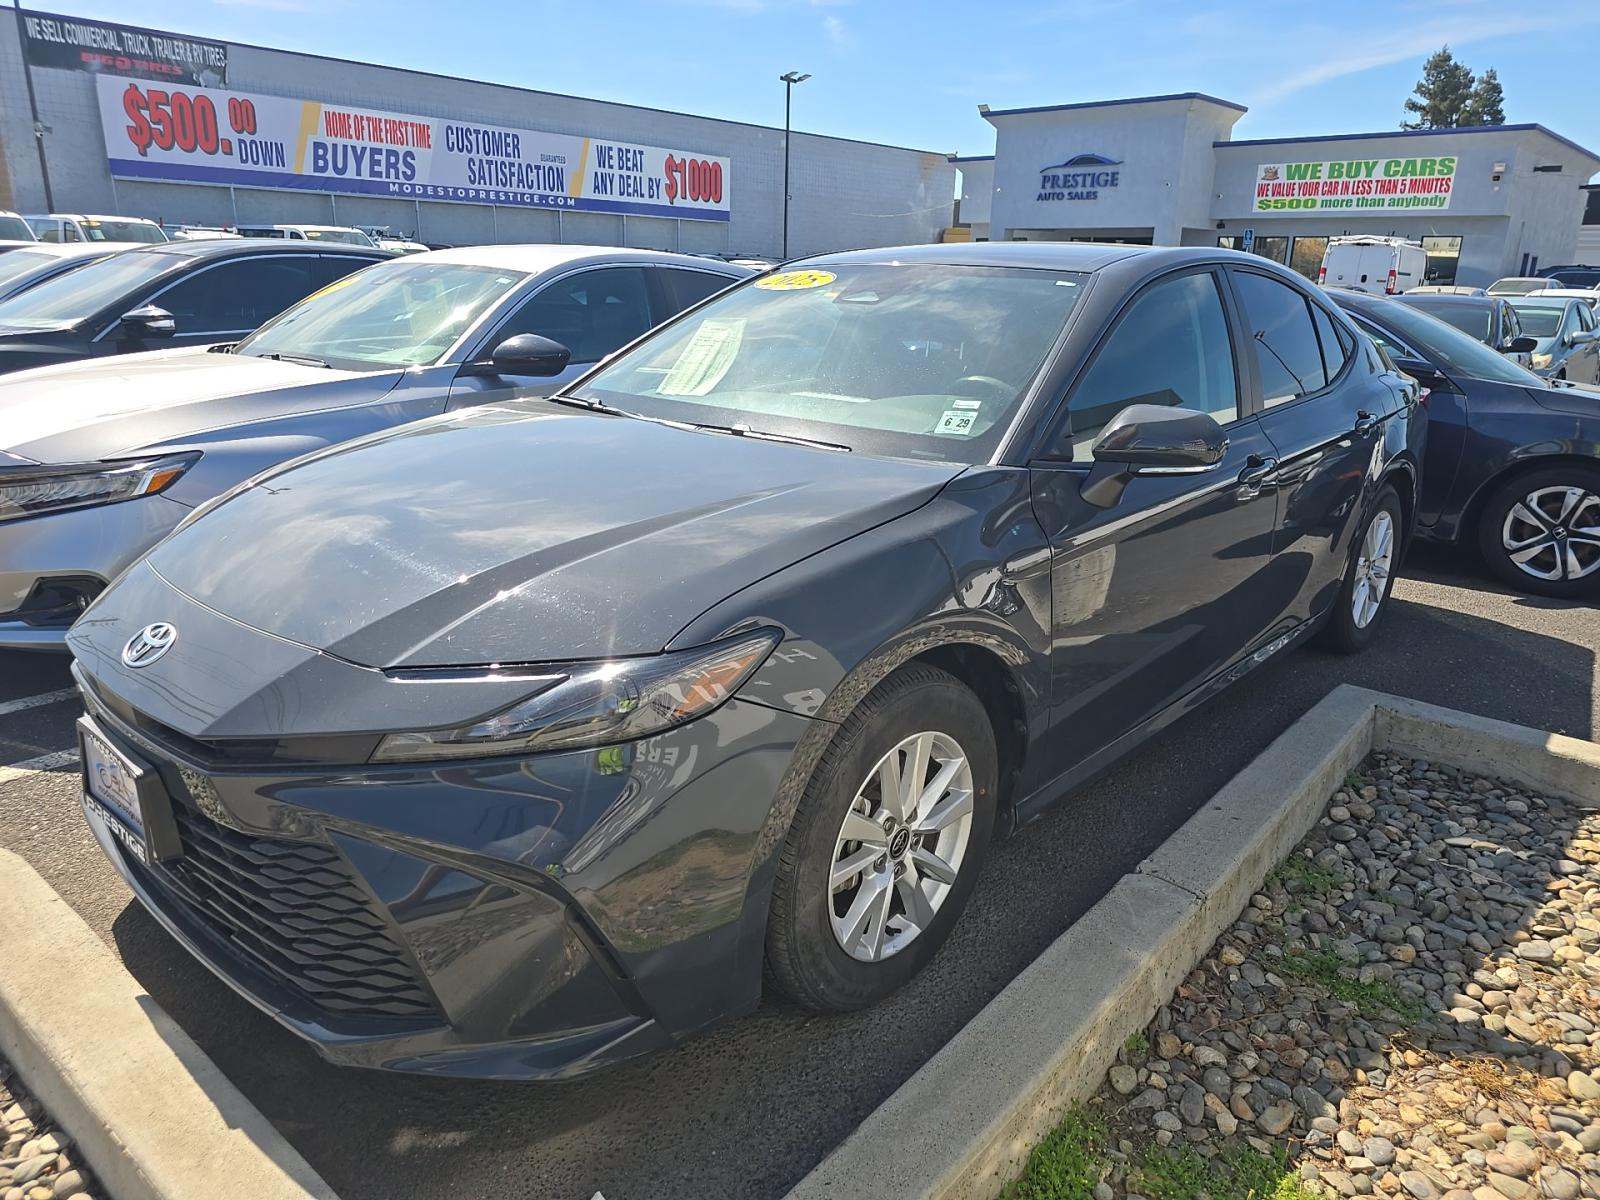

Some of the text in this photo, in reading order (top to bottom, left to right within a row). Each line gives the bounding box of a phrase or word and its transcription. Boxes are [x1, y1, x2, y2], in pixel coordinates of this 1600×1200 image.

[24, 16, 42, 39] WE
[41, 19, 65, 43] SELL
[152, 37, 187, 61] TRAILER
[191, 43, 204, 64] RV
[203, 45, 226, 67] TIRES
[131, 58, 183, 76] TIRES
[324, 110, 431, 149] HOME OF THE FIRST TIME
[445, 125, 521, 159] CUSTOMER
[238, 138, 286, 168] DOWN
[312, 141, 416, 181] BUYERS
[596, 144, 644, 173] WE BEAT
[467, 157, 564, 193] SATISFACTION
[664, 153, 723, 205] $1000
[1041, 171, 1120, 189] PRESTIGE
[1286, 157, 1456, 180] WE BUY CARS
[389, 182, 576, 206] MODESTOPRESTIGE.COM
[593, 171, 661, 200] ANY DEAL BY
[1036, 191, 1098, 201] AUTO SALES
[1257, 177, 1452, 197] WE VALUE YOUR CAR IN LESS THAN 5 MINUTES
[1258, 195, 1447, 210] $500 more than anybody
[944, 417, 971, 428] 6 29
[85, 795, 146, 863] PRESTIGE
